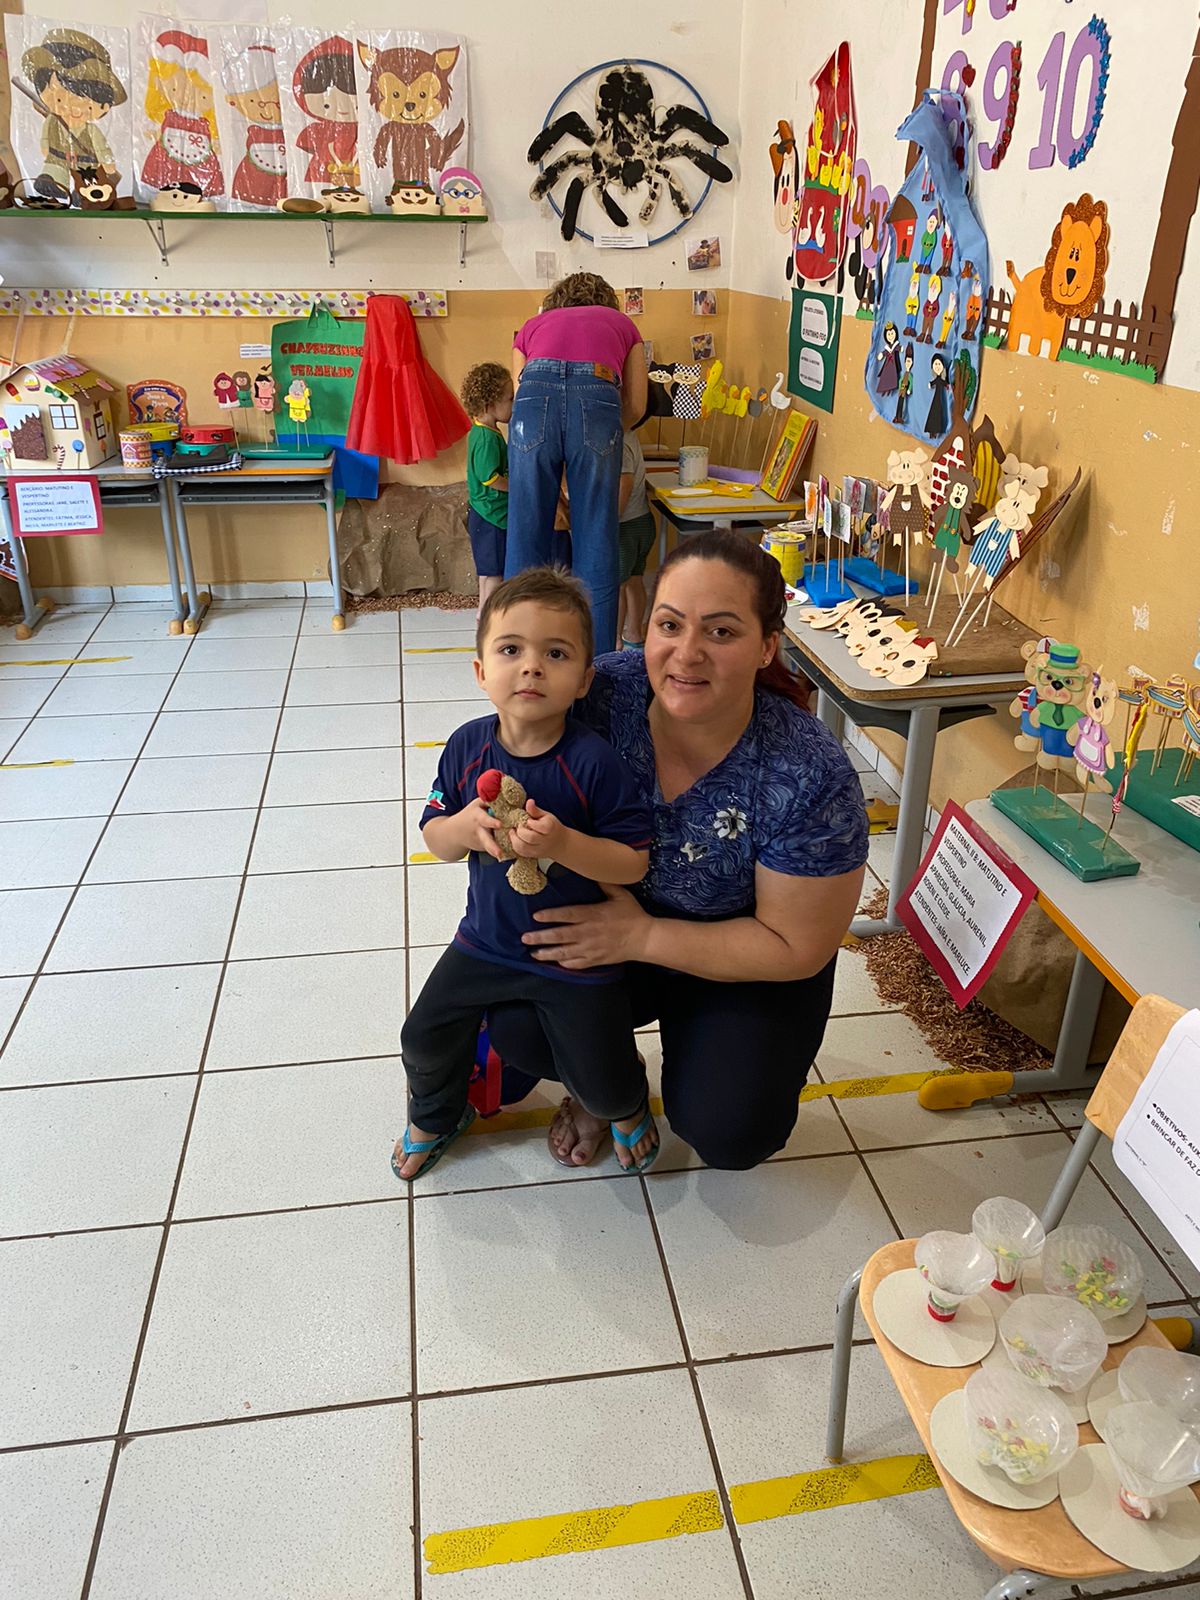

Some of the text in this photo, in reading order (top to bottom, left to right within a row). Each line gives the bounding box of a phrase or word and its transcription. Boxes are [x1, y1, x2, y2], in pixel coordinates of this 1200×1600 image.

[978, 41, 1022, 170] 9
[1028, 14, 1112, 170] 10
[290, 365, 354, 378] VERMELHO
[942, 836, 967, 869] VESPERTINO
[949, 823, 972, 853] MATERNAL
[976, 858, 1003, 892] MATUTINO
[1000, 887, 1007, 897] E
[922, 875, 936, 897] ROSENI
[934, 892, 939, 901] E
[928, 863, 951, 896] APARECIDA,
[935, 850, 976, 908] PROFESSORAS: MARIA
[946, 937, 951, 947] E
[1156, 1107, 1188, 1143] OBJETIVOS:
[1151, 1119, 1176, 1148] BRINCAR
[1176, 1146, 1185, 1157] DE
[1184, 1156, 1196, 1171] FAZ
